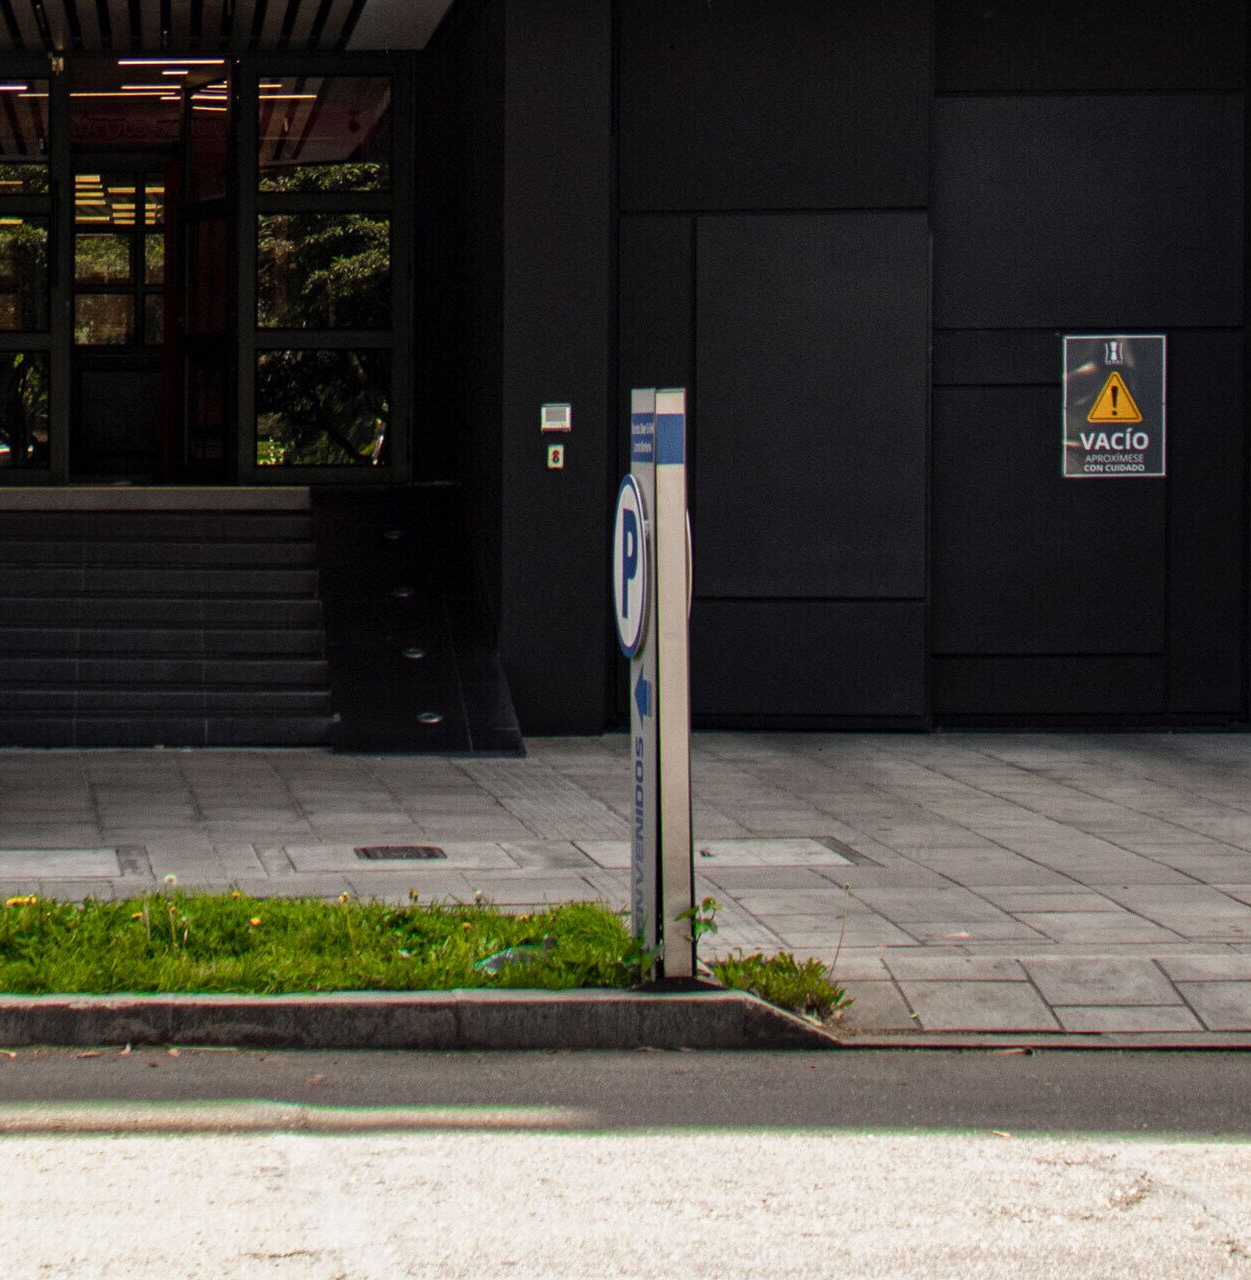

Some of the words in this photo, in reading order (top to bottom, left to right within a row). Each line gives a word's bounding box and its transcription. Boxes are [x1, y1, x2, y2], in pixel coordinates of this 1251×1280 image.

[1079, 427, 1150, 451] VACÍO
[1085, 453, 1144, 464] APROXÍMESE
[1084, 464, 1105, 473] CON
[1105, 464, 1145, 473] CUIDADO
[622, 508, 638, 619] P
